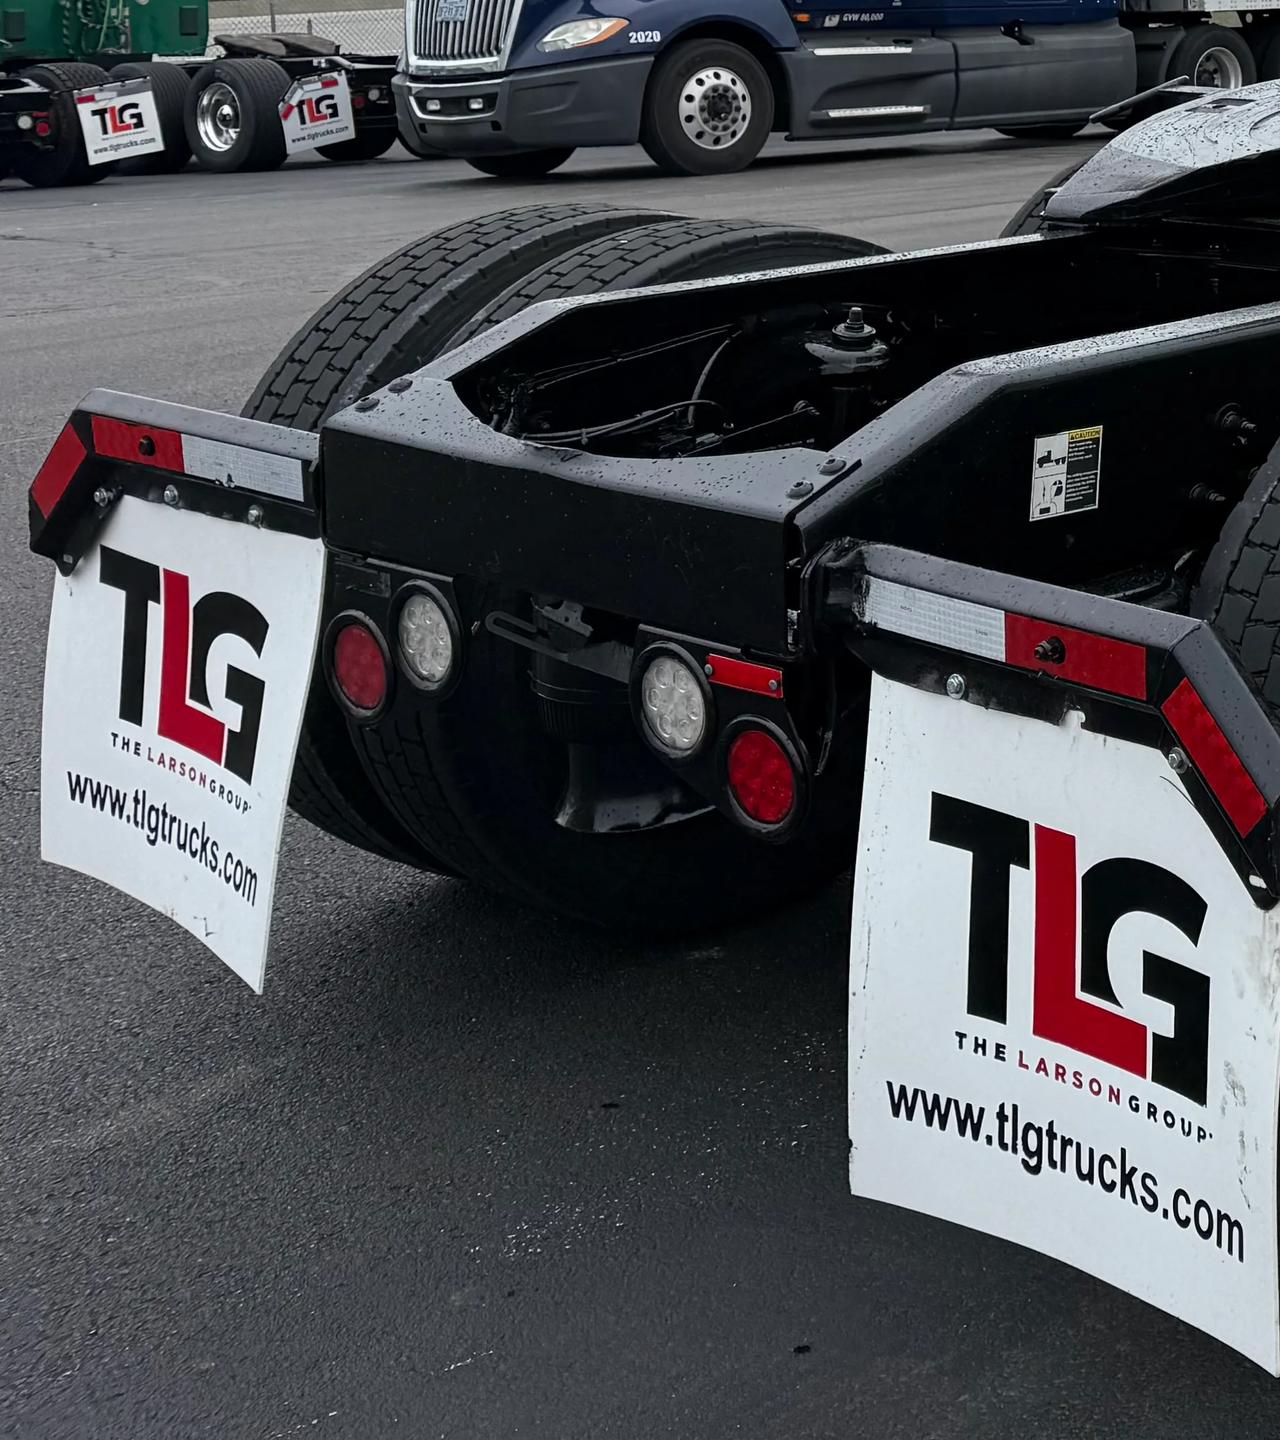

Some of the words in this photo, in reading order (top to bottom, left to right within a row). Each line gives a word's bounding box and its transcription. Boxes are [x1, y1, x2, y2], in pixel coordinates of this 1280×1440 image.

[628, 31, 661, 44] 2020
[91, 102, 144, 136] TLG
[299, 93, 340, 126] TLG
[99, 543, 270, 786] TLG
[111, 732, 142, 757] THE
[67, 771, 258, 907] www.tlgtrucks.com
[929, 791, 1211, 1109] TLG
[955, 1031, 1007, 1062] THE
[886, 1080, 1244, 1263] www.tlgtrucks.com
